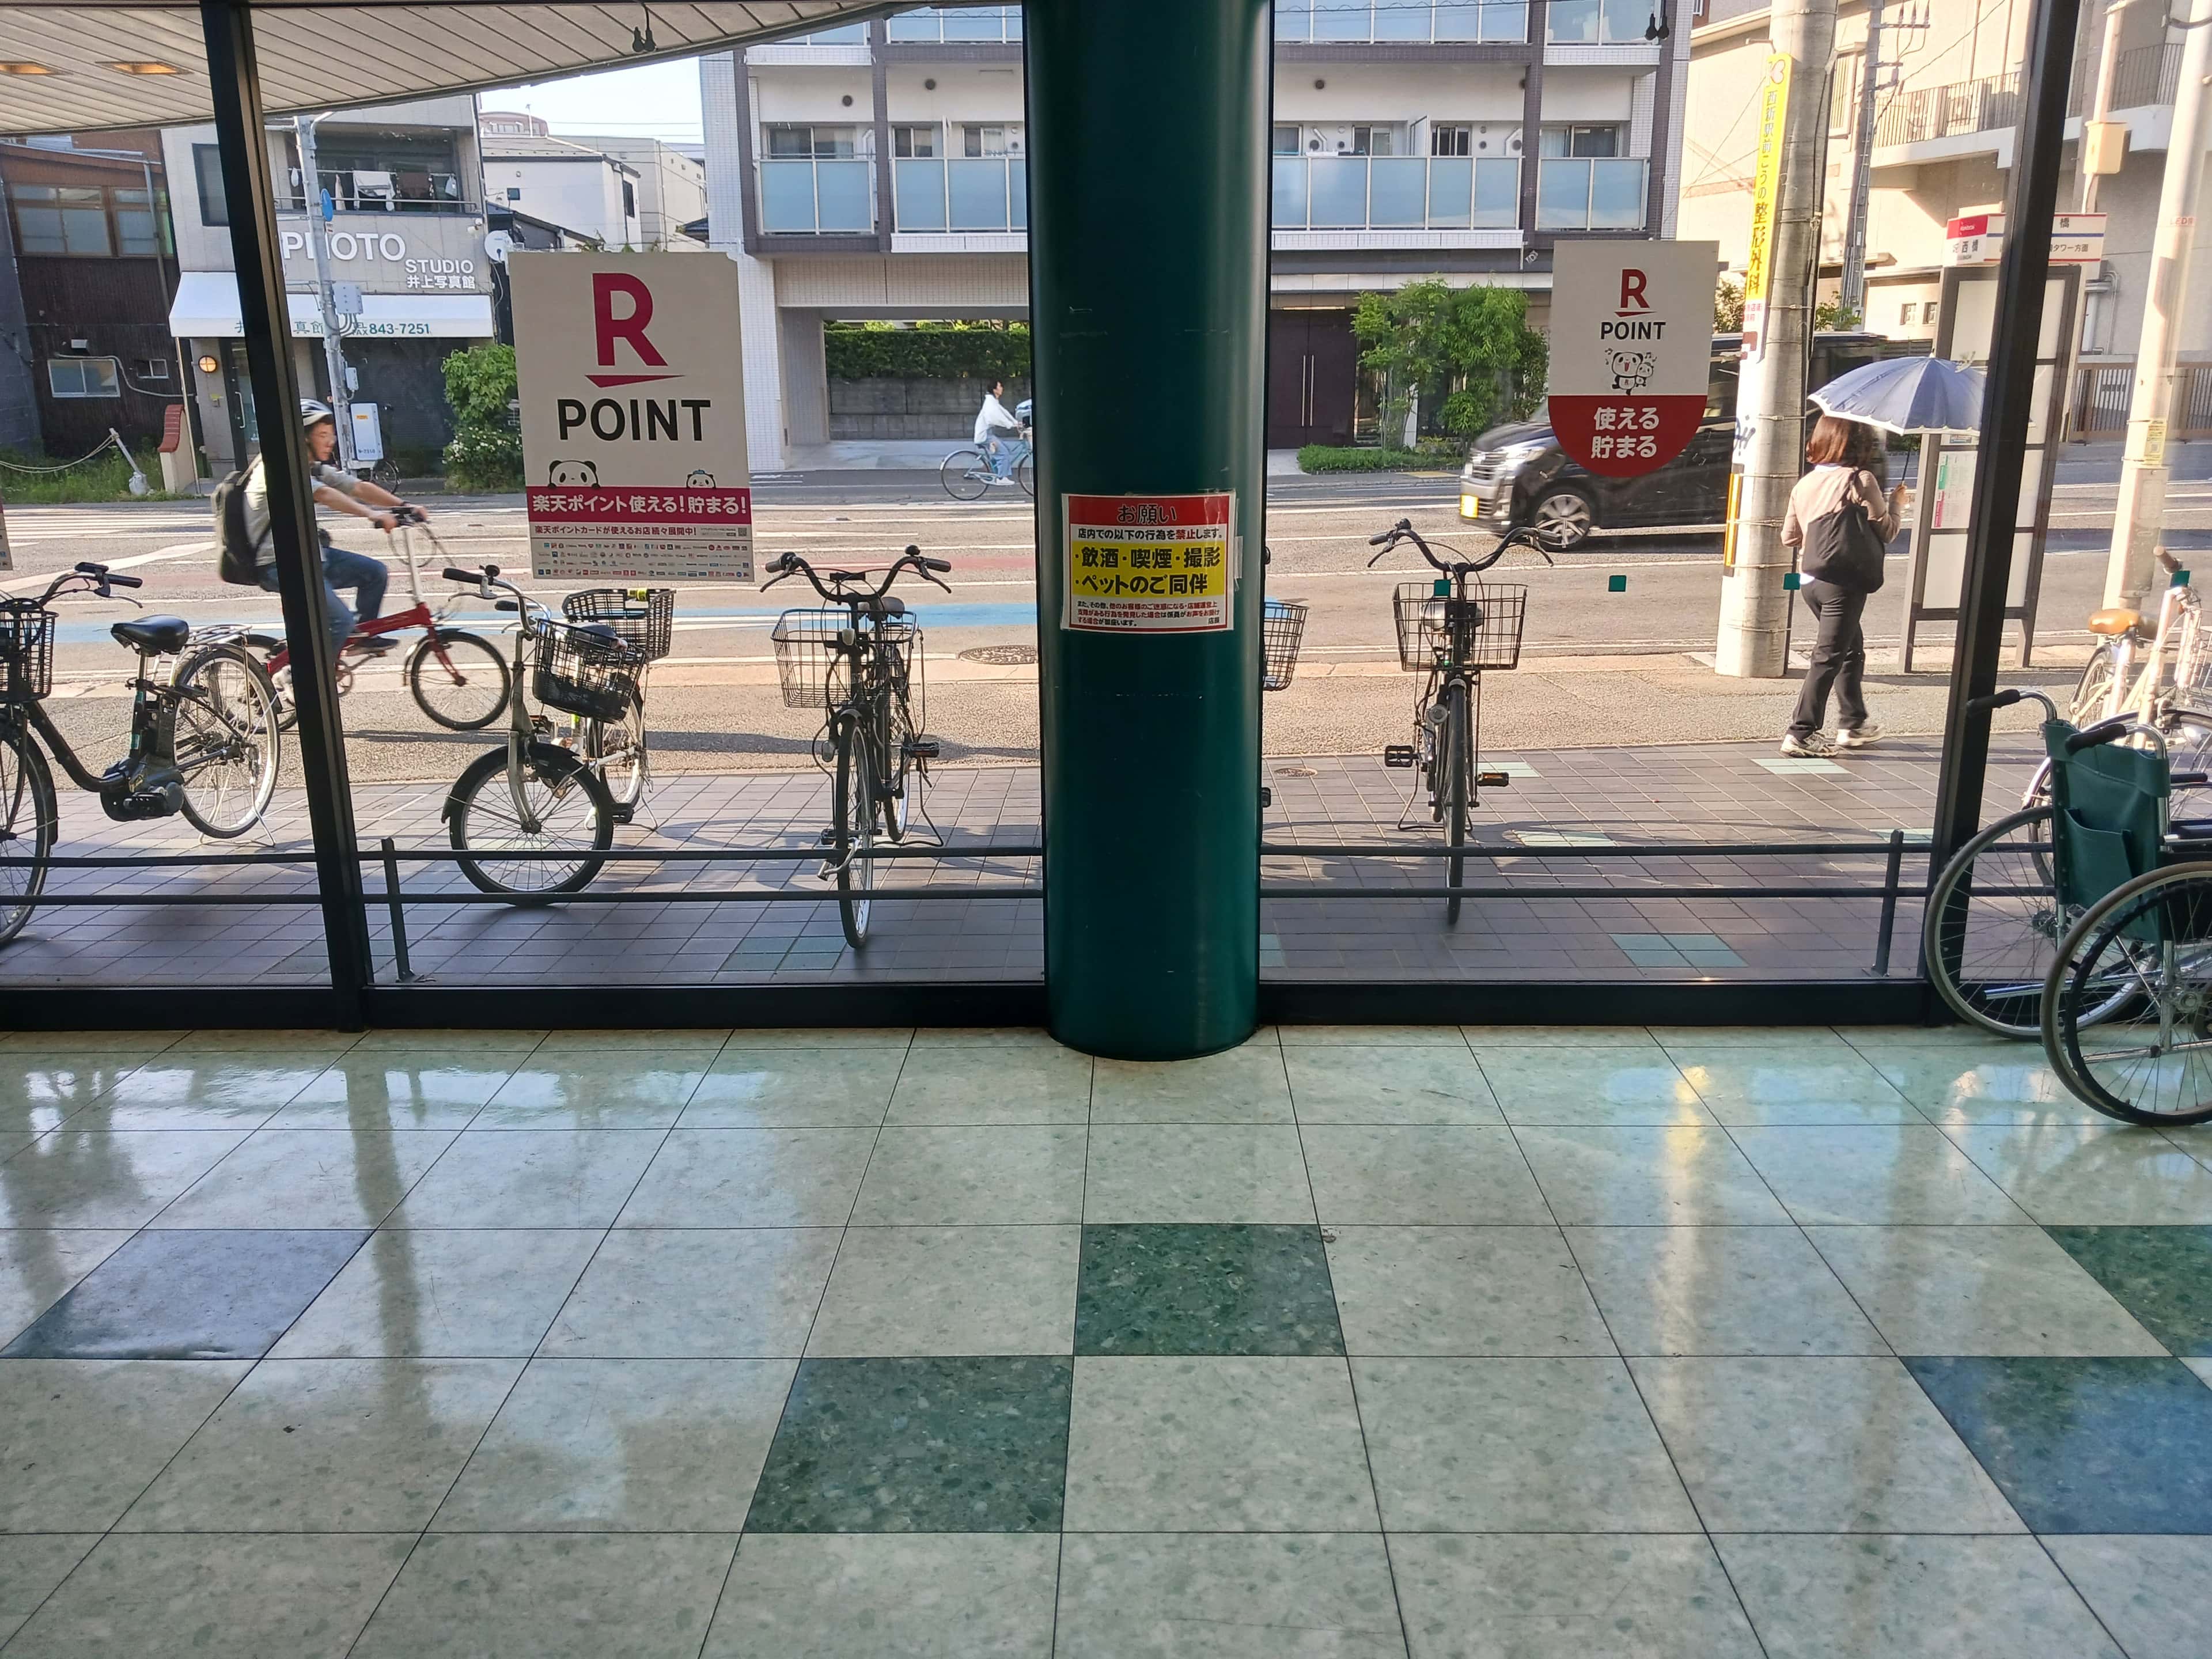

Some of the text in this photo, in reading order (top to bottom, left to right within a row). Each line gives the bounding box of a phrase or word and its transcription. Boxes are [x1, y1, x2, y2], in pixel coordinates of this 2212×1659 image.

[405, 259, 474, 274] STUDIO
[407, 274, 475, 289] 井上写真館
[1620, 268, 1650, 309] R
[369, 323, 430, 335] 843-7251
[592, 272, 668, 366] R
[1600, 321, 1666, 340] POINT
[557, 398, 711, 442] POINT
[1593, 407, 1660, 431] 使える
[1590, 435, 1657, 459] 貯まる
[1116, 503, 1177, 525] お願い
[1077, 528, 1223, 541] 店内での以下の行為を禁止します。
